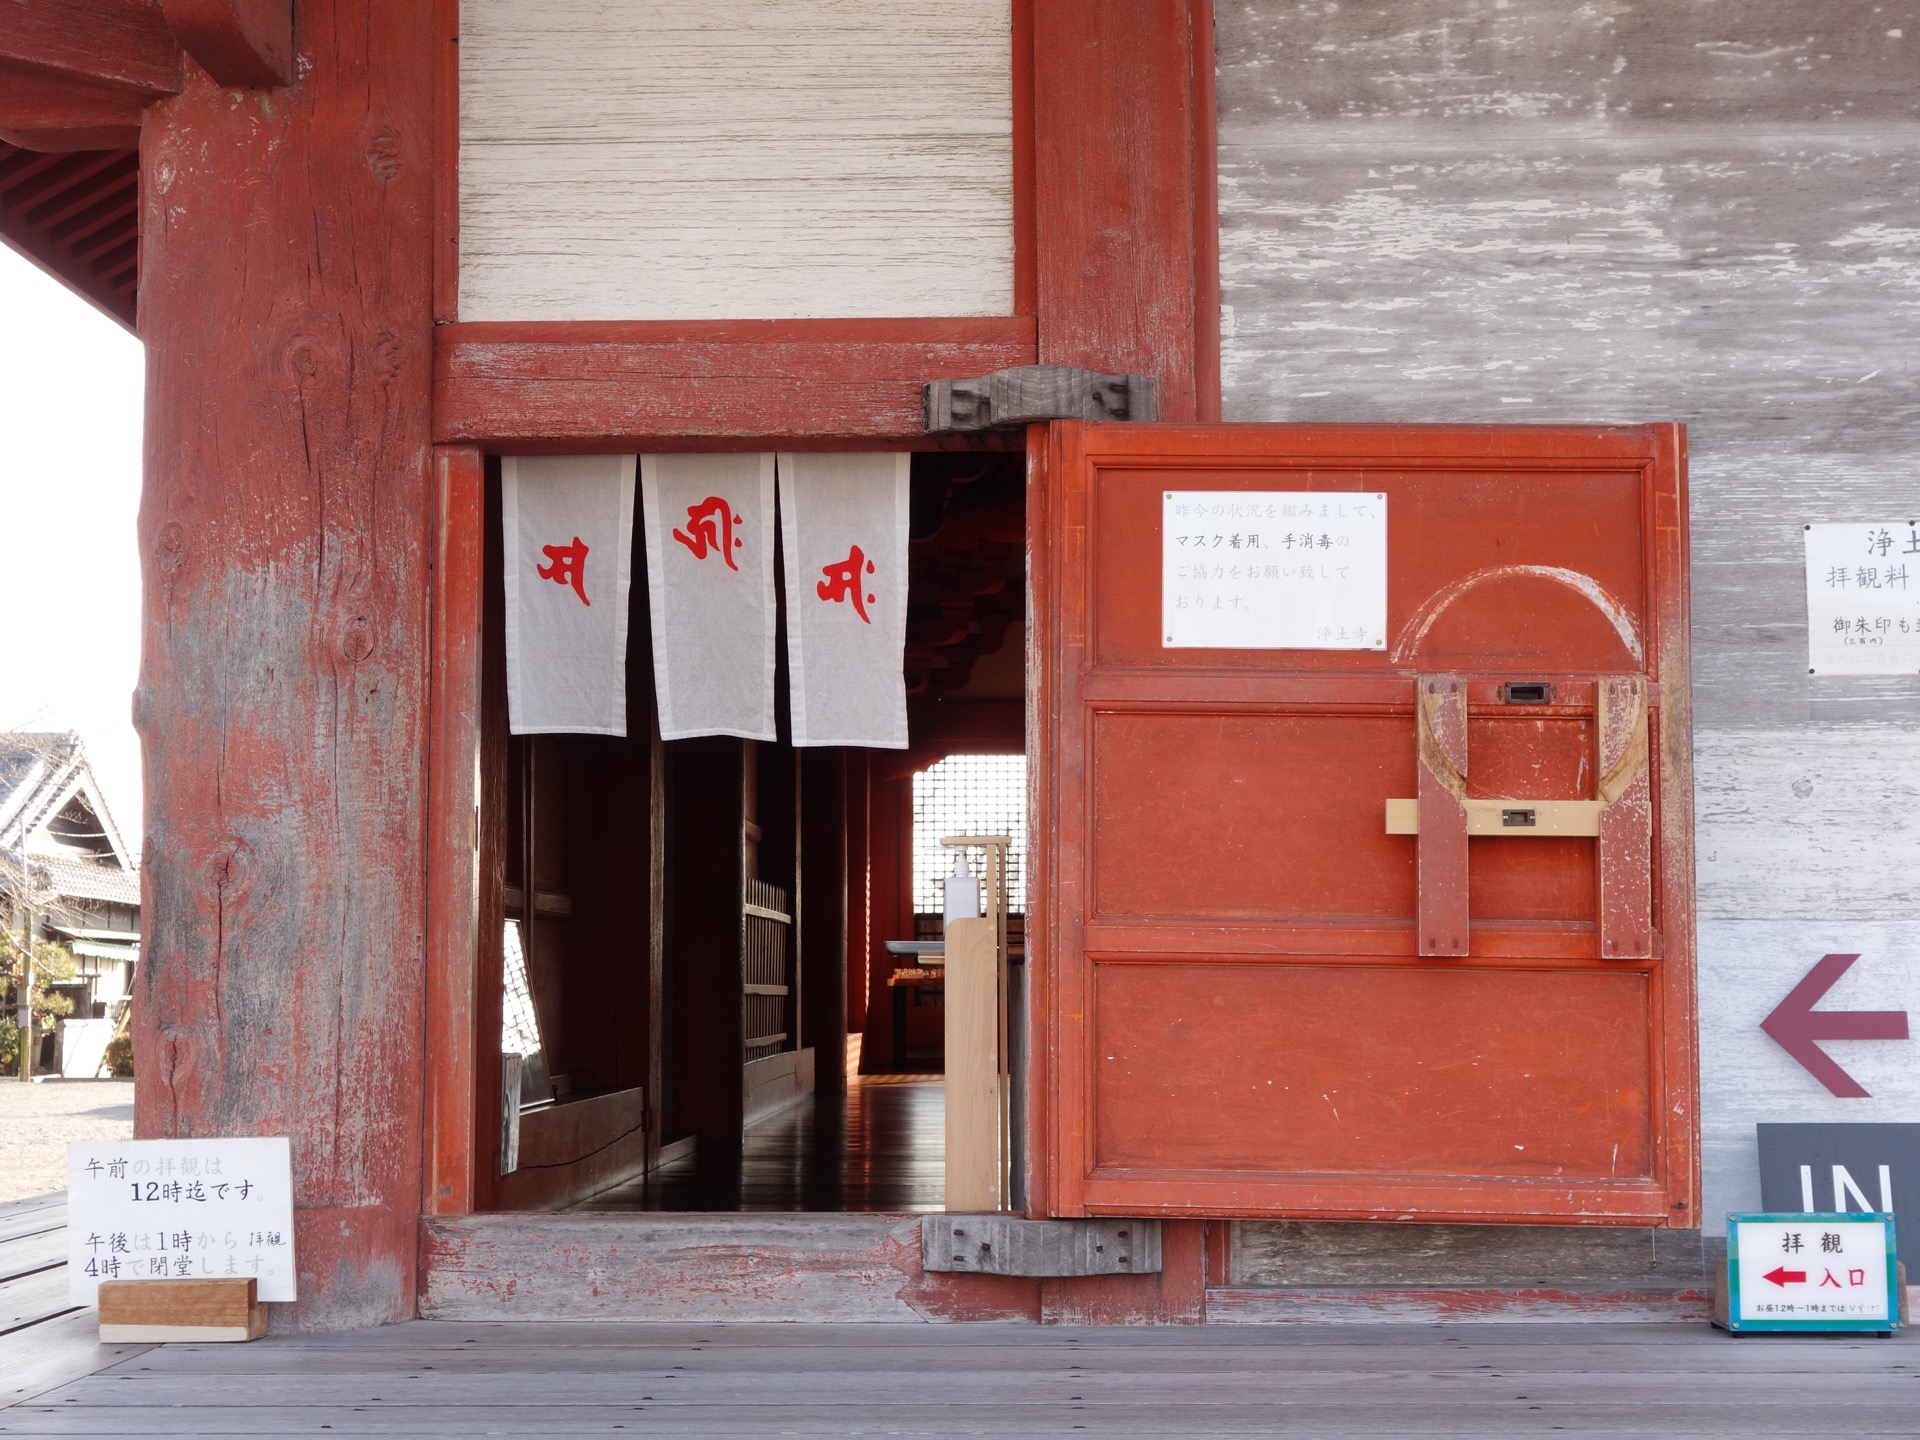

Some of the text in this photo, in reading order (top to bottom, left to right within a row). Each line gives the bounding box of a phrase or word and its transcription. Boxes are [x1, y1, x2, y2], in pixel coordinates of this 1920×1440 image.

[1176, 503, 1375, 518] 昨今の状況を鑑みまして、
[1176, 533, 1349, 550] マスク着用、手消毒の
[1178, 565, 1349, 579] ご協力をお願い致して
[1827, 564, 1909, 589] 拝観料
[1176, 595, 1249, 610] おります。
[1318, 627, 1367, 642] 浄土寺
[84, 1157, 221, 1179] 午前の拝観は
[131, 1180, 264, 1203] 12時迄です。
[1801, 1165, 1893, 1211] IN
[1782, 1232, 1843, 1254] 拝観
[84, 1256, 273, 1277] 4時で閉堂します。
[1820, 1268, 1864, 1288] 入口
